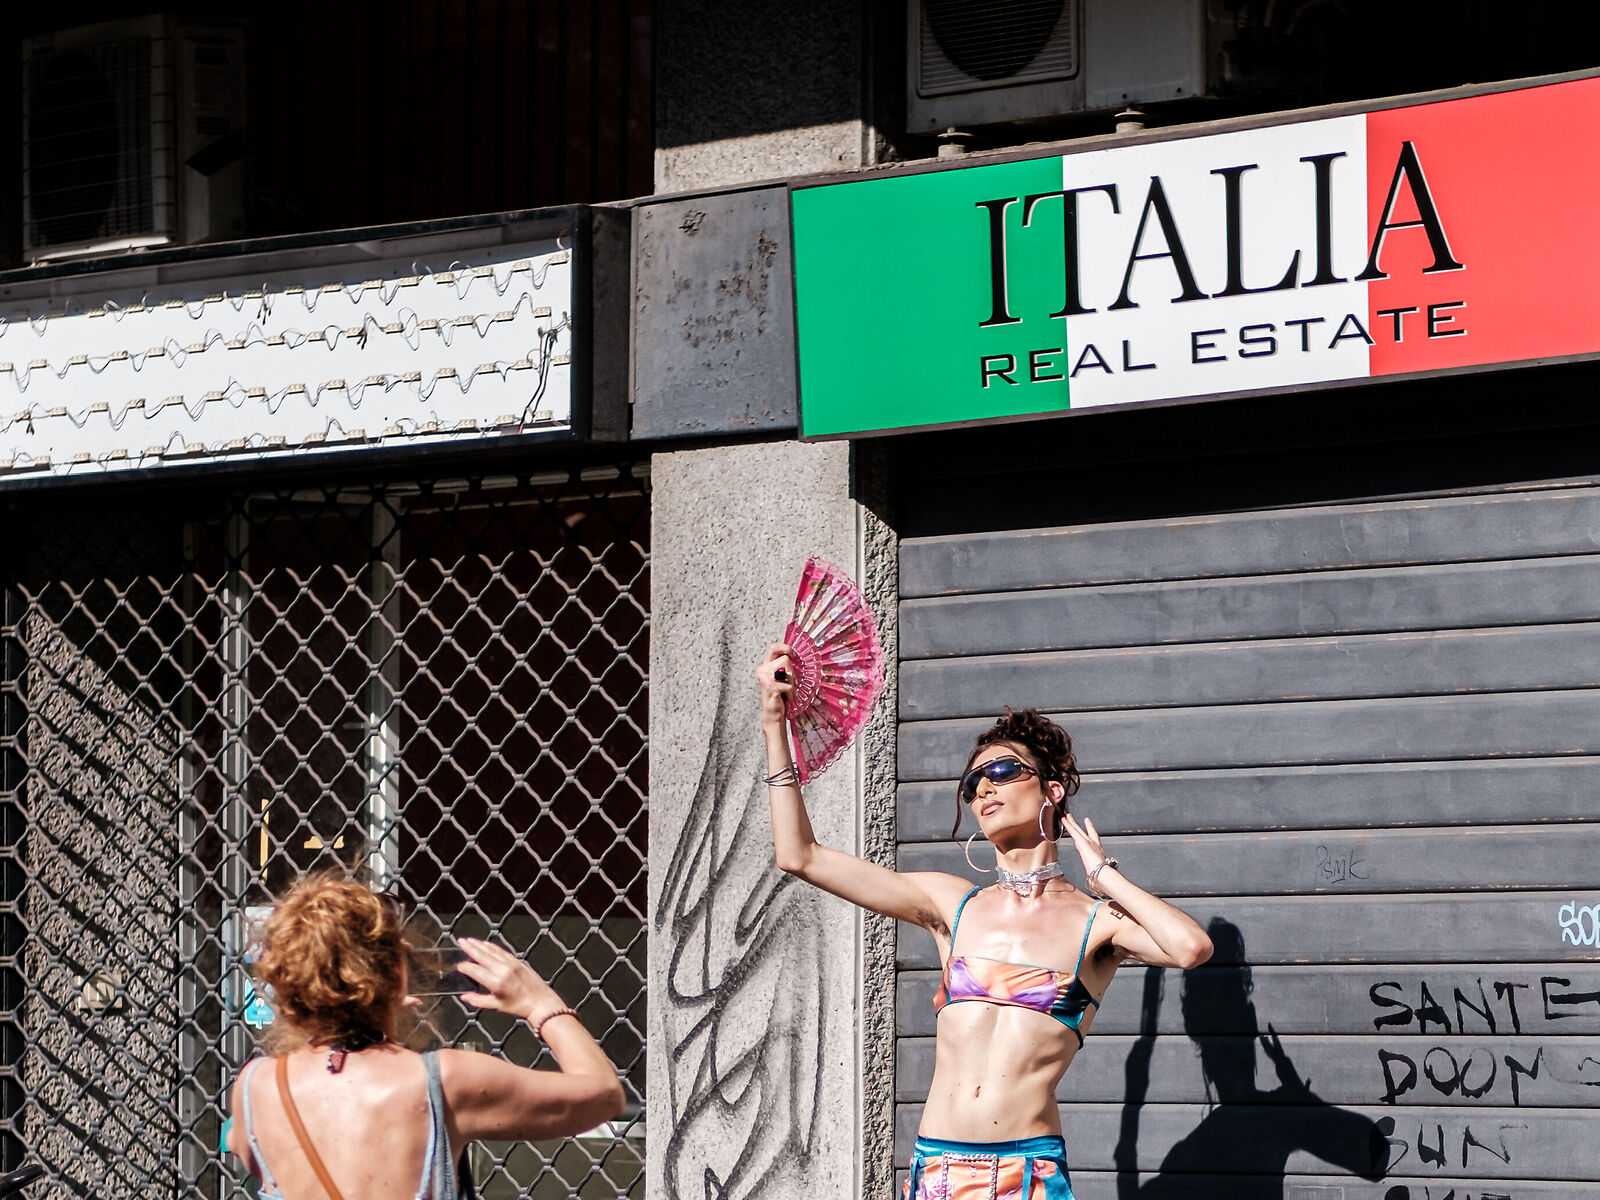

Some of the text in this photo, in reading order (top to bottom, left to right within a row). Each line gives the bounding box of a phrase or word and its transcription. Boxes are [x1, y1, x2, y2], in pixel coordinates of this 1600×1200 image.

[976, 141, 1466, 327] ITALIA
[980, 301, 1468, 388] REAL ESTATE
